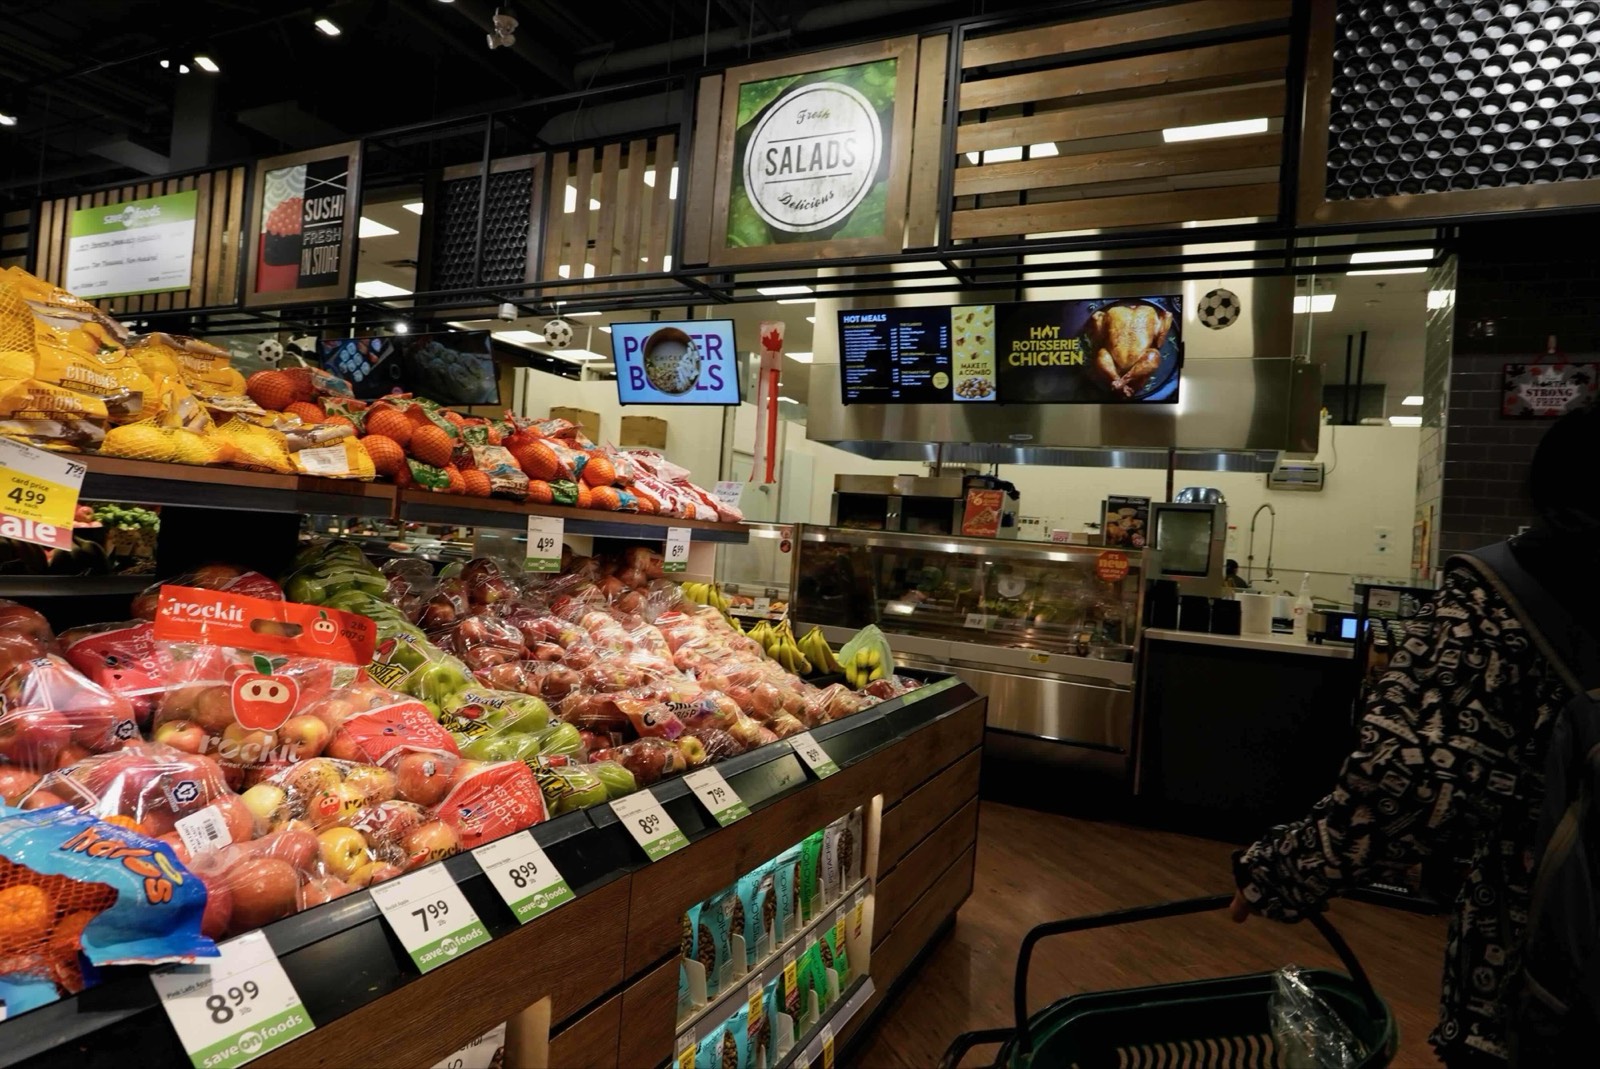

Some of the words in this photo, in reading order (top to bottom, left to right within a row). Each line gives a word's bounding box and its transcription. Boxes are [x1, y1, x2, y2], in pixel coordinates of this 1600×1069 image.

[796, 108, 831, 125] Fresh
[765, 138, 857, 177] SALADS
[304, 194, 345, 222] SUSHI
[777, 190, 835, 211] Delicious
[303, 227, 342, 246] FRESH
[300, 247, 312, 276] IN
[311, 244, 341, 275] STORE
[843, 315, 860, 323] HOT
[860, 313, 887, 323] MEALS
[623, 334, 723, 361] PER
[1012, 338, 1081, 351] ROTISSERIE
[1008, 351, 1084, 367] CHICKEN
[629, 364, 724, 391] BLS
[1526, 388, 1574, 397] STRONG
[8, 487, 46, 504] 499
[12, 476, 29, 487] card
[30, 481, 50, 493] price
[537, 537, 554, 552] 499
[672, 545, 684, 557] 699
[1098, 559, 1127, 569] new
[173, 601, 247, 622] rockit
[340, 629, 358, 640] 907
[416, 710, 444, 738] CRISP
[198, 734, 302, 764] rockit
[480, 785, 515, 827] HONEY
[494, 784, 526, 815] CRISP
[706, 787, 726, 805] 799
[638, 814, 660, 835] 899
[508, 861, 538, 888] 899
[518, 901, 536, 915] save
[545, 886, 567, 901] foods
[751, 879, 762, 942] PISTACHIOS
[411, 900, 449, 932] 799
[419, 947, 444, 963] save
[455, 928, 483, 946] foods
[205, 980, 259, 1024] 899
[203, 1045, 240, 1068] save
[261, 1014, 303, 1040] foods
